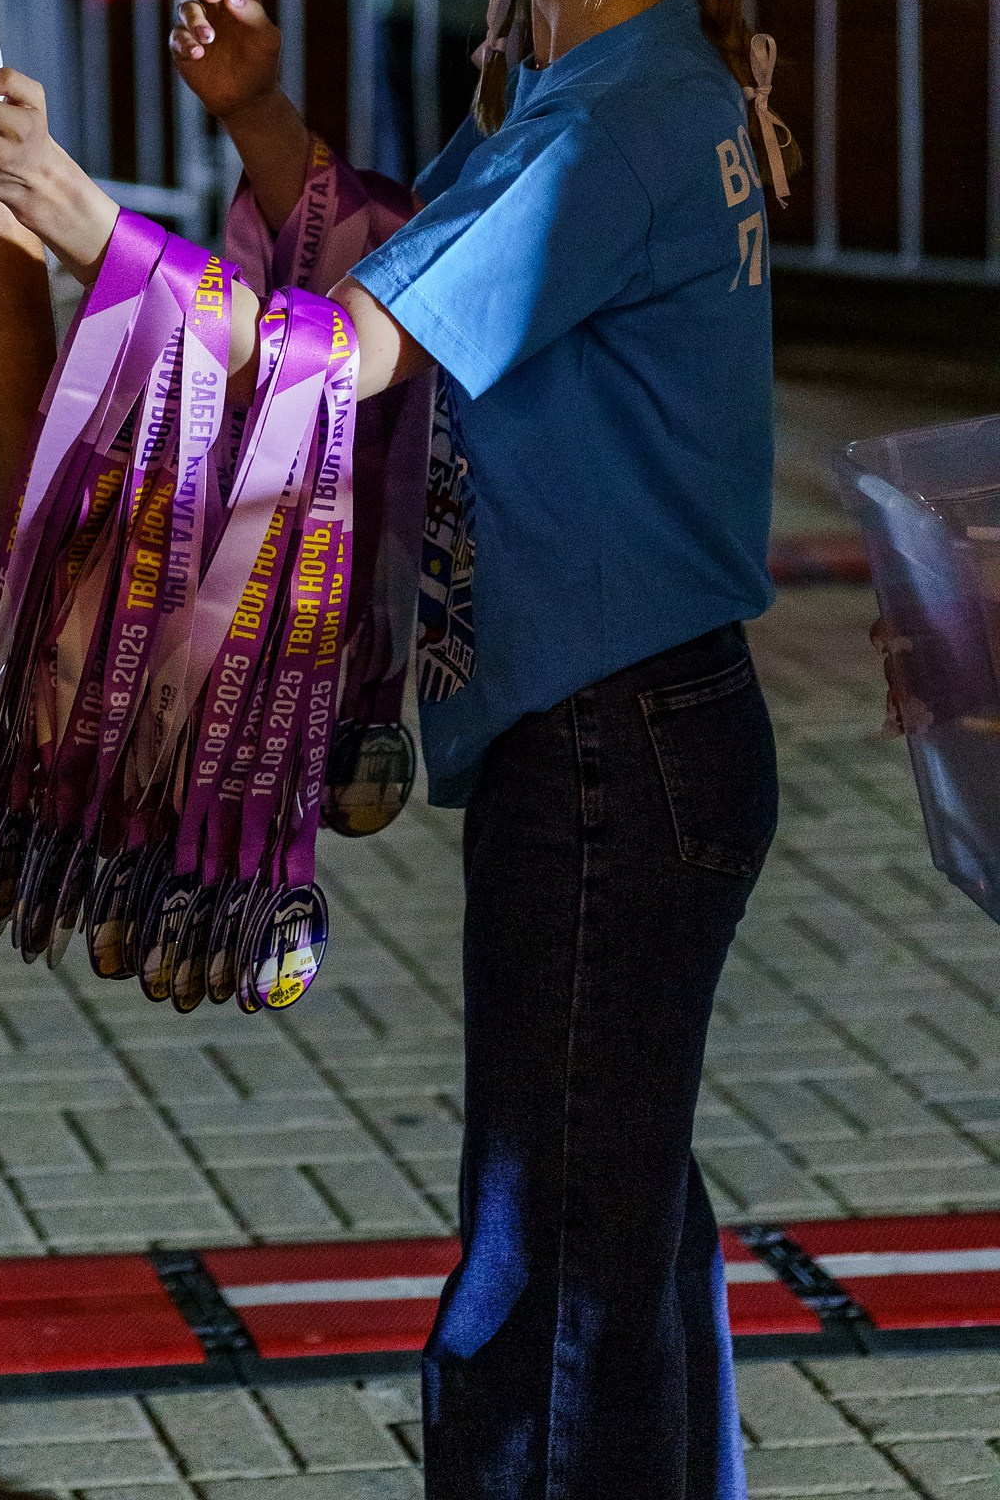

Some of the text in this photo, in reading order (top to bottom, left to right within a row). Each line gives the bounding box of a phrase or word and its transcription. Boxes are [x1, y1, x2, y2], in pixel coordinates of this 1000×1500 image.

[141, 482, 176, 546] НОЧЬ
[127, 548, 162, 610] ТВОЯ
[230, 579, 269, 641] ТВОЯ
[285, 521, 333, 658] ТВОЯ НОЧЬ.
[102, 623, 149, 756] 16.08.2025
[195, 653, 250, 786] 16.08.2025
[251, 669, 304, 798] 16.08.2025
[306, 680, 332, 810] 16.08.2025
